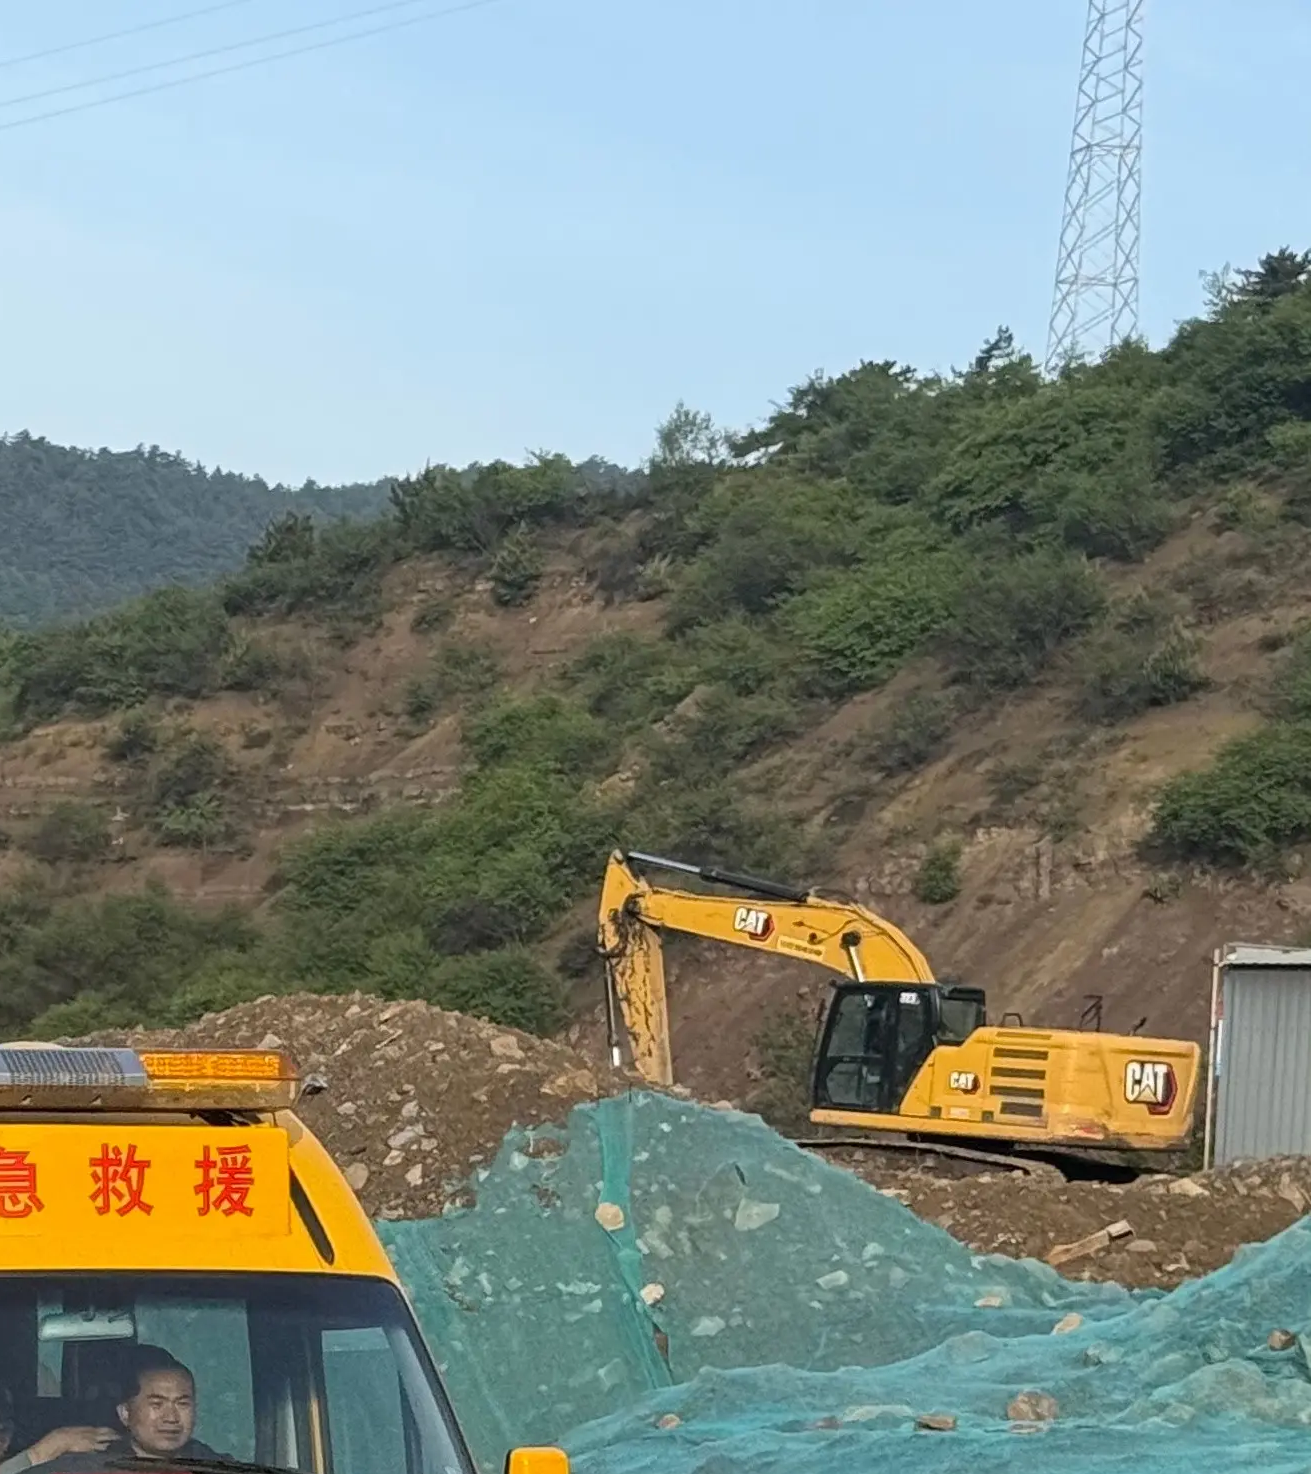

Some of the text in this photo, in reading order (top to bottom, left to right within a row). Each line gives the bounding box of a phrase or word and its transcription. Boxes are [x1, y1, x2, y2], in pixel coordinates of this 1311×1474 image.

[734, 907, 769, 935] CAT
[950, 1071, 976, 1090] CAT
[1125, 1061, 1168, 1103] CAT
